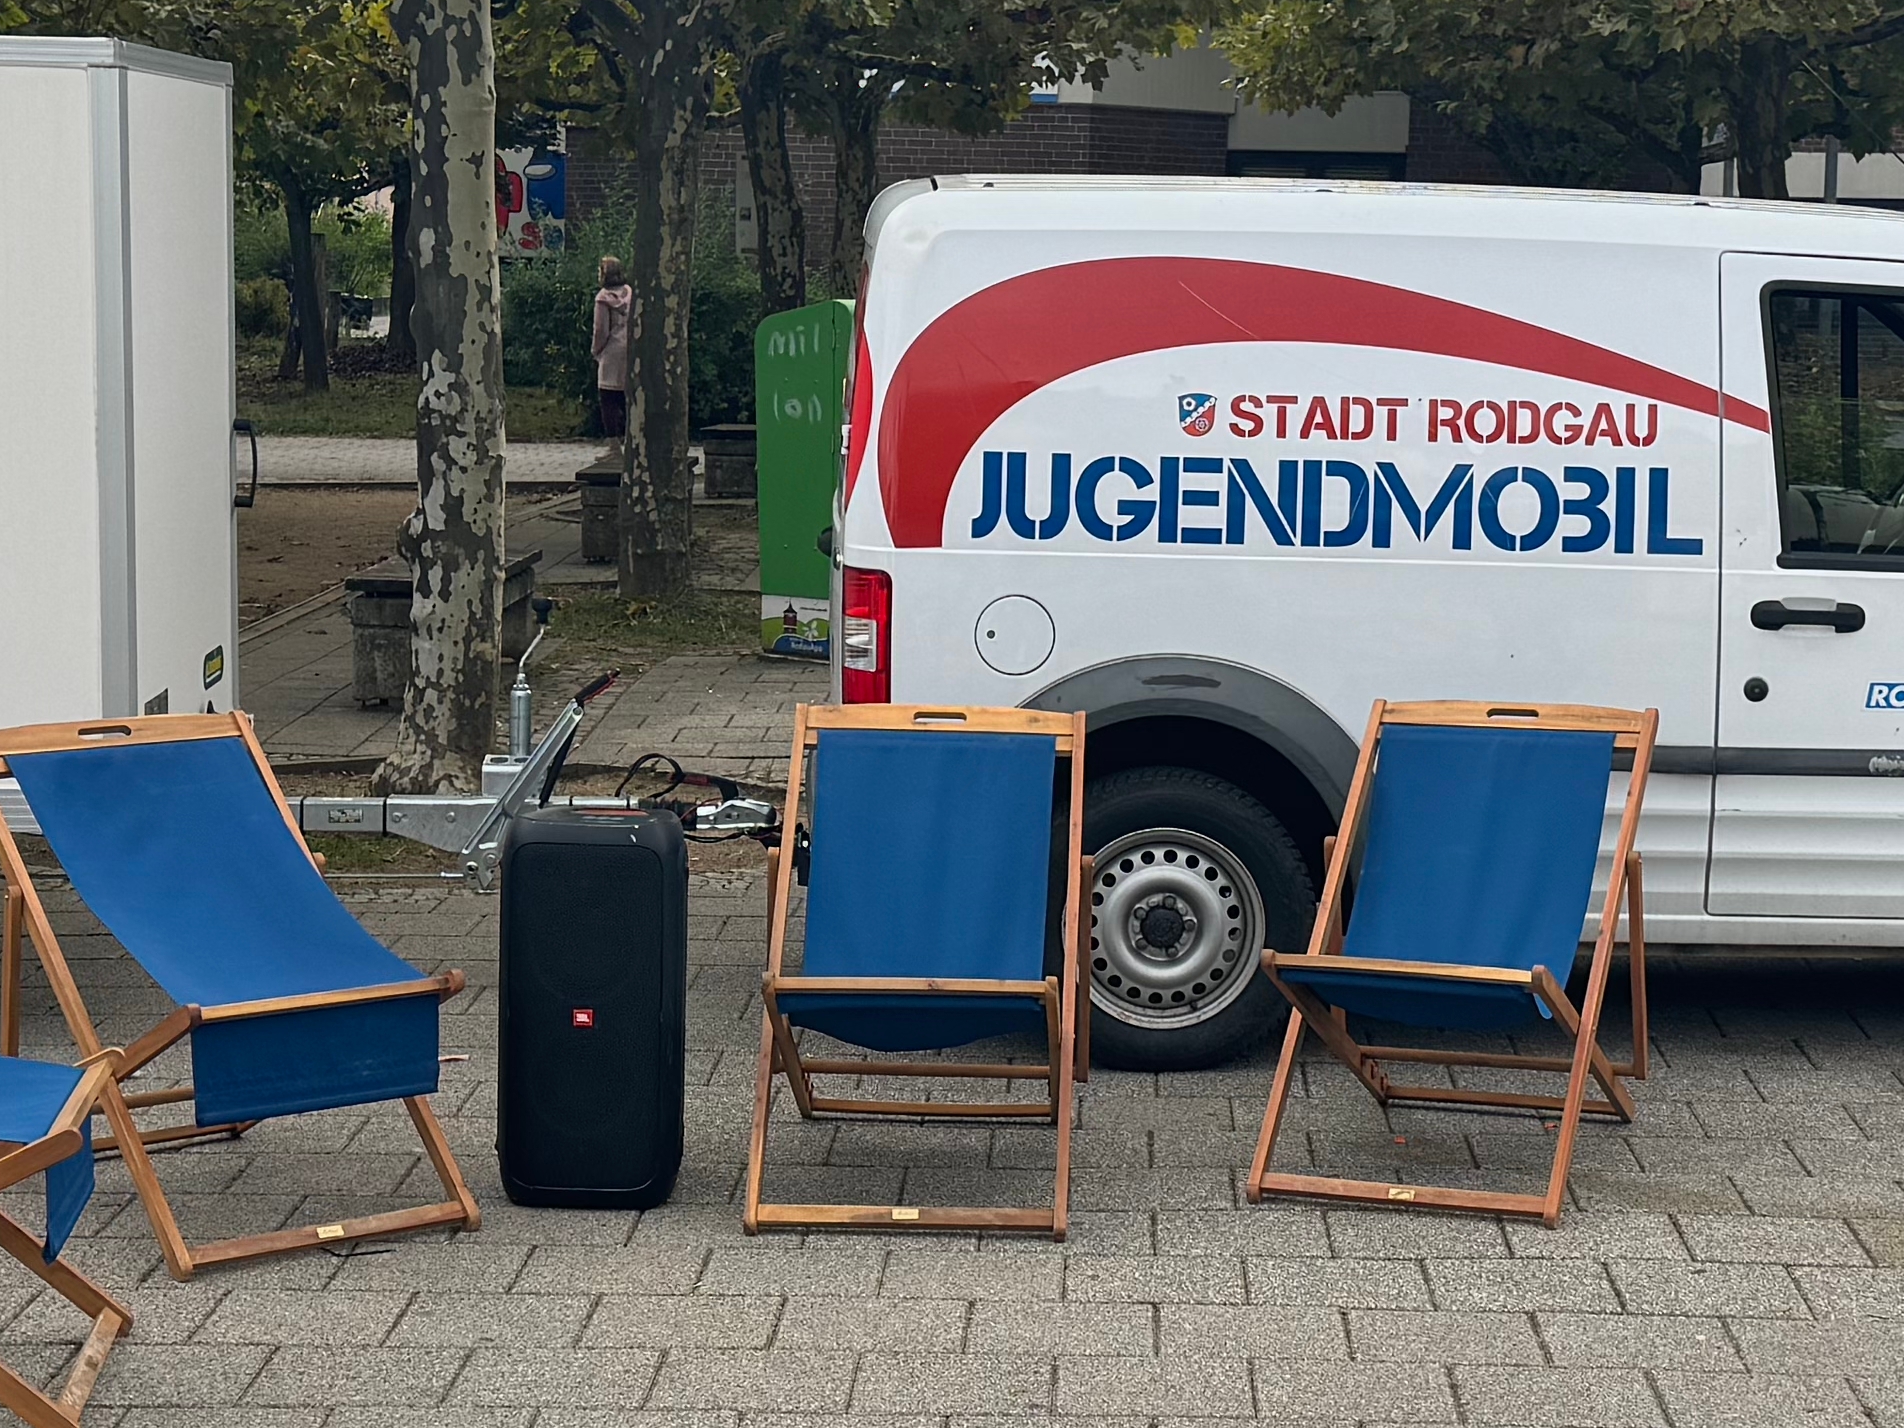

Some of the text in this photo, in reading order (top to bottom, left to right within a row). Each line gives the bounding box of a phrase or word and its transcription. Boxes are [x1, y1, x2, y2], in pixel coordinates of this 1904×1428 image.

[1228, 394, 1658, 448] STADT RODGAU
[970, 450, 1704, 556] JUGENDMOBIL
